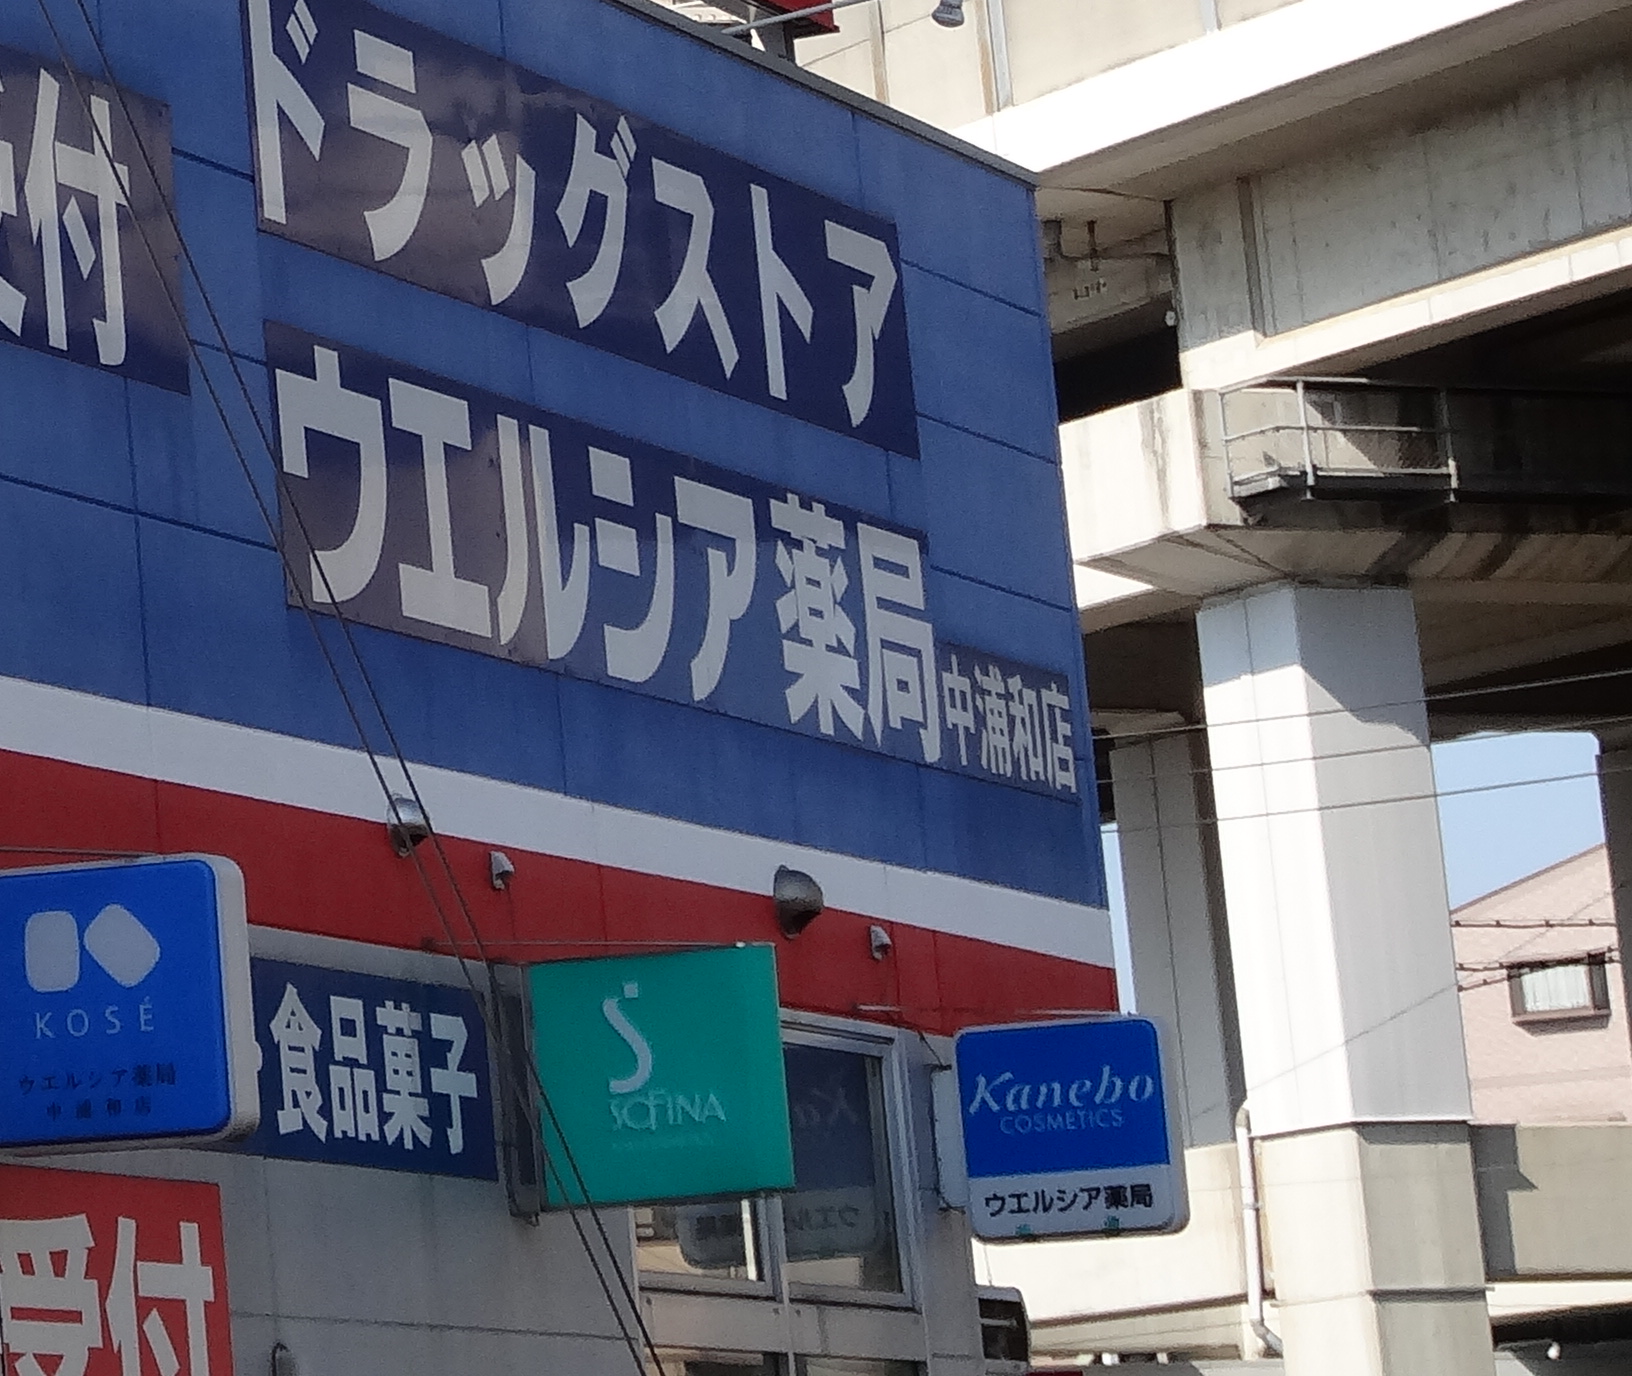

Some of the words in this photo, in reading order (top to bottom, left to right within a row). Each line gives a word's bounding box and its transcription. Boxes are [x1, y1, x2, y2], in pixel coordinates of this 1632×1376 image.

[275, 344, 941, 764] ウエルシア薬局
[942, 654, 1076, 794] 中浦和店
[36, 995, 154, 1039] KOSÉ
[269, 982, 478, 1155] 食品菓子
[968, 1064, 1154, 1114] Kanebo
[610, 1088, 727, 1131] SOFINA
[999, 1108, 1123, 1135] COSMETICS
[985, 1183, 1153, 1217] ウエルシア薬局
